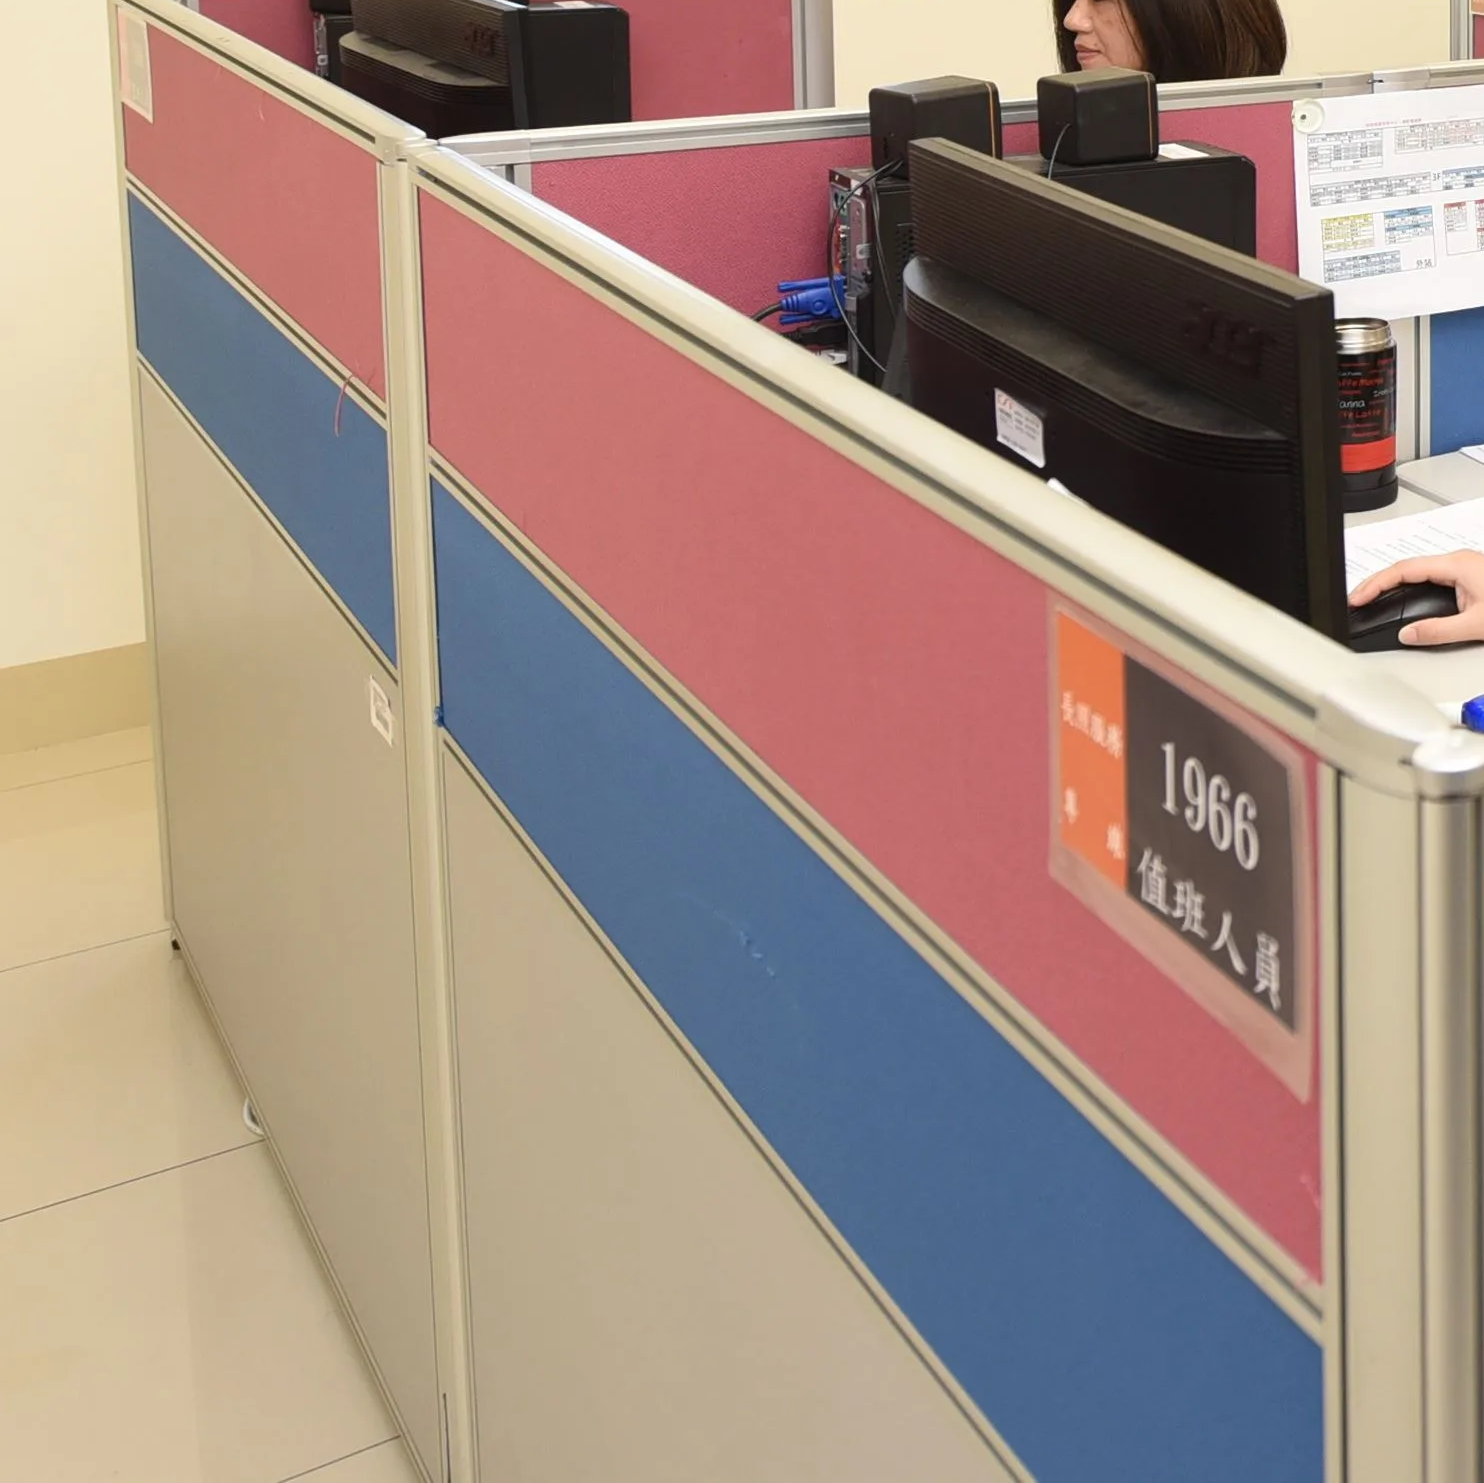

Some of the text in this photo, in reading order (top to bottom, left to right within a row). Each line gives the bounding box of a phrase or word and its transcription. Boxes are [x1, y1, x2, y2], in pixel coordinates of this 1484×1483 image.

[1431, 172, 1441, 182] 3F
[1160, 740, 1260, 872] 1966
[1136, 846, 1282, 1011] 值班人員
